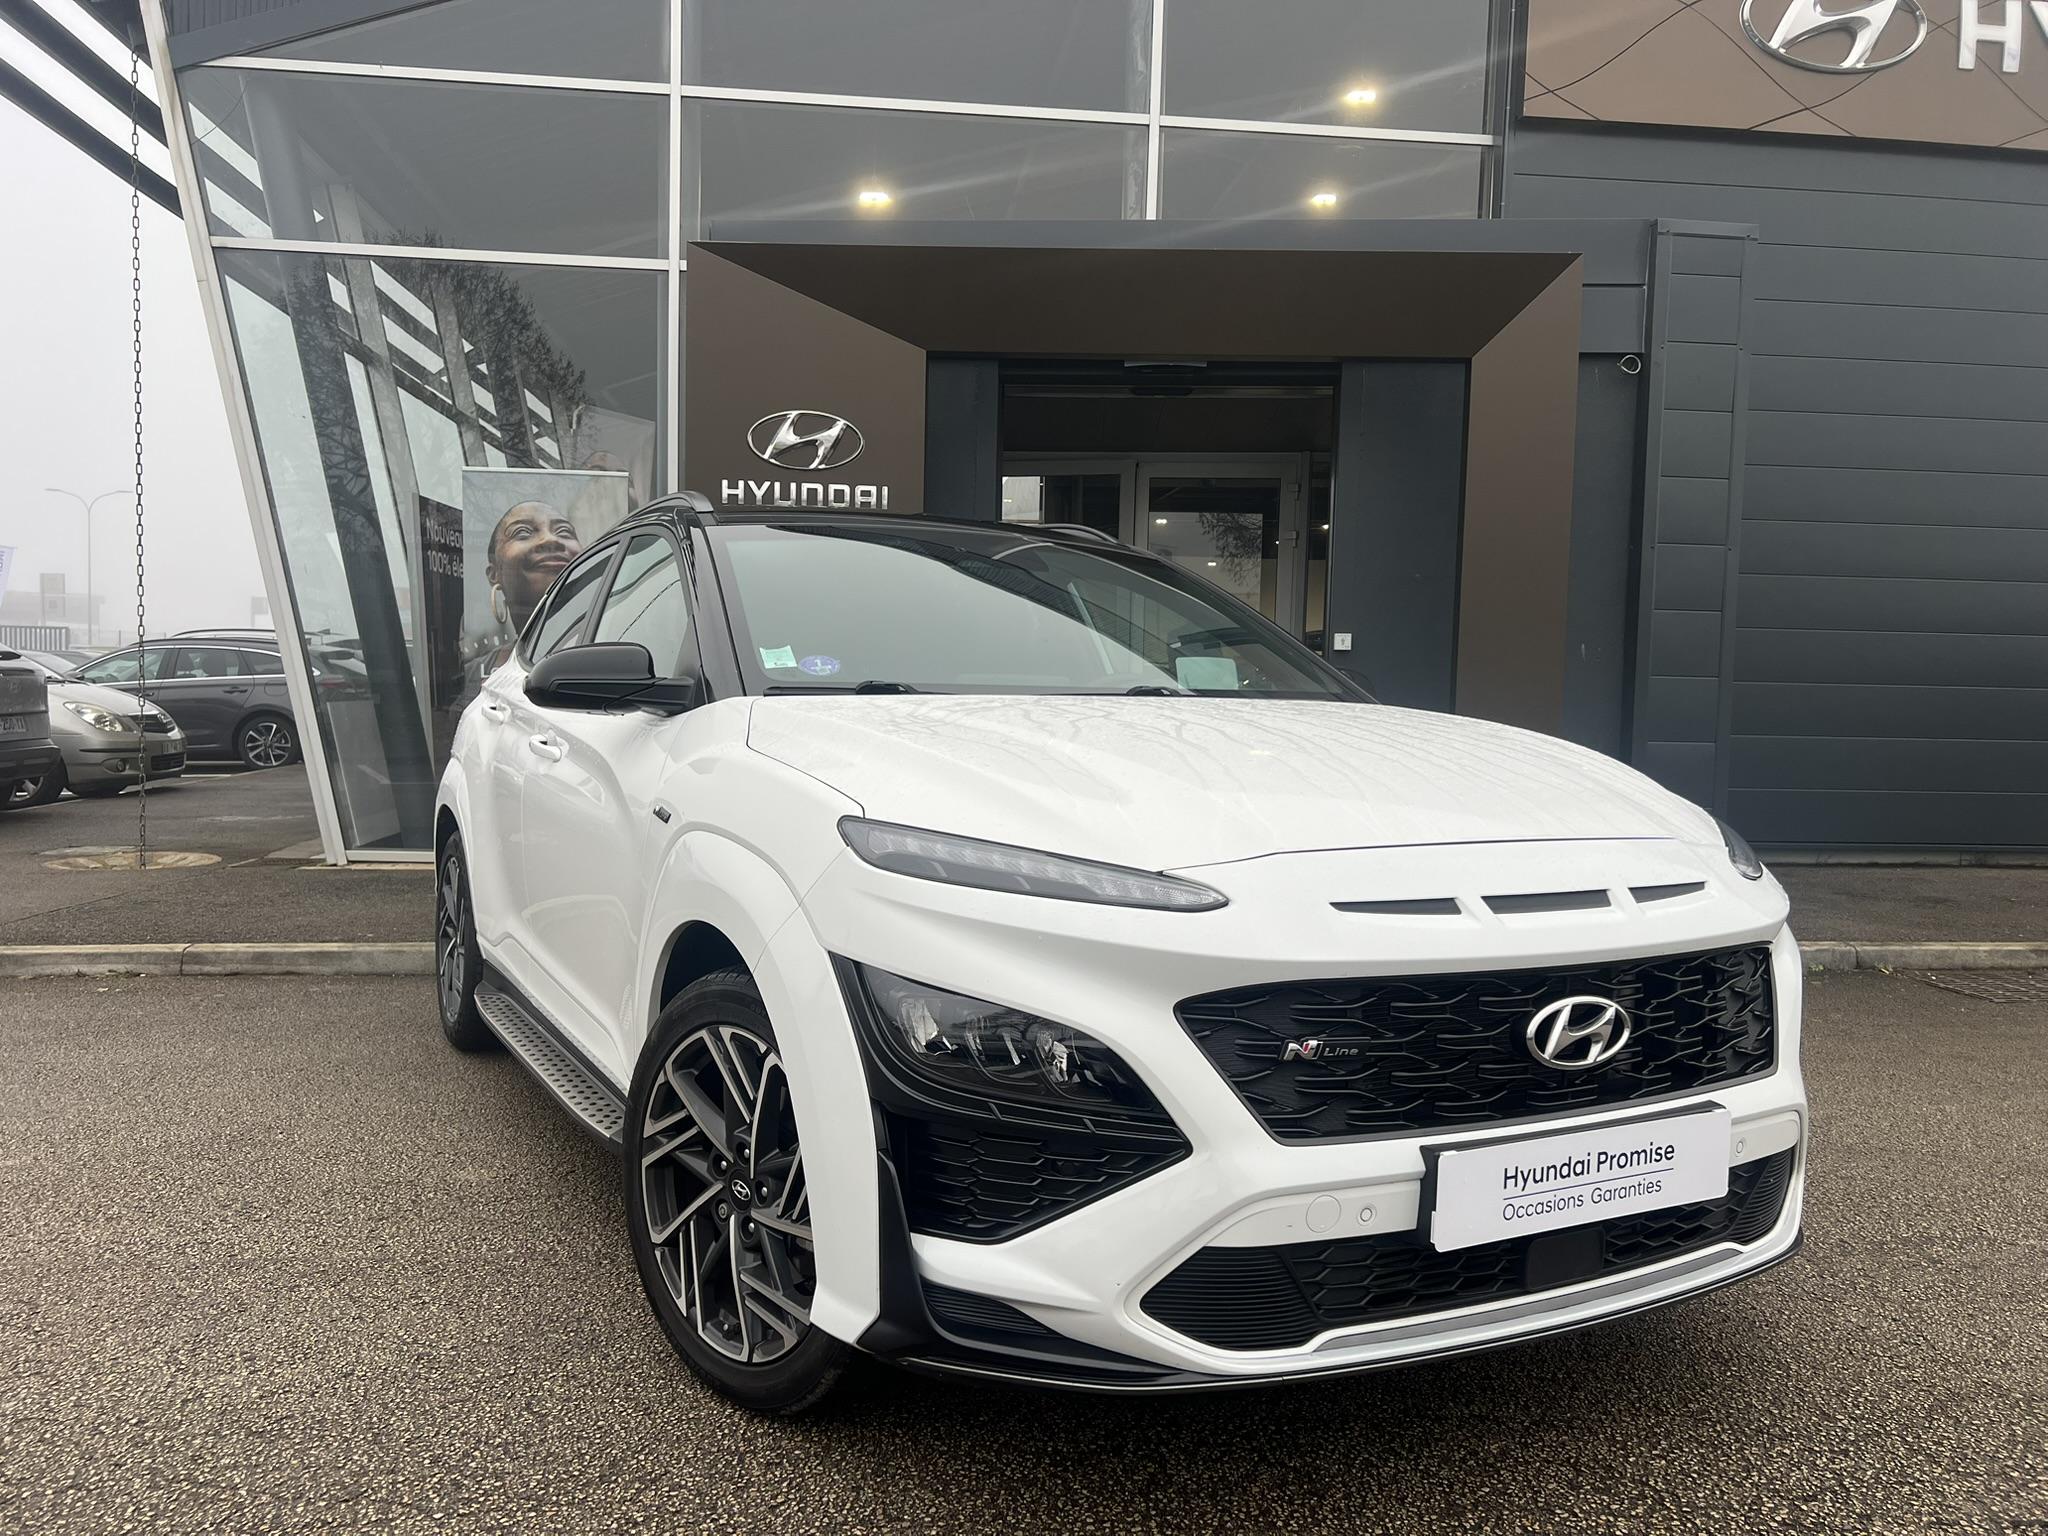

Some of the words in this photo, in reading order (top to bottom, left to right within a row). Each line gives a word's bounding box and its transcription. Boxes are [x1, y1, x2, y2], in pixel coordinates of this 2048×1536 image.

[721, 478, 889, 511] HYUNDAI
[427, 549, 451, 575] 100%
[1323, 1047, 1360, 1057] Line
[1503, 1152, 1591, 1192] Hyundai
[1596, 1141, 1675, 1173] Promise
[1502, 1194, 1584, 1221] Occasions
[1590, 1177, 1663, 1205] Garanties
